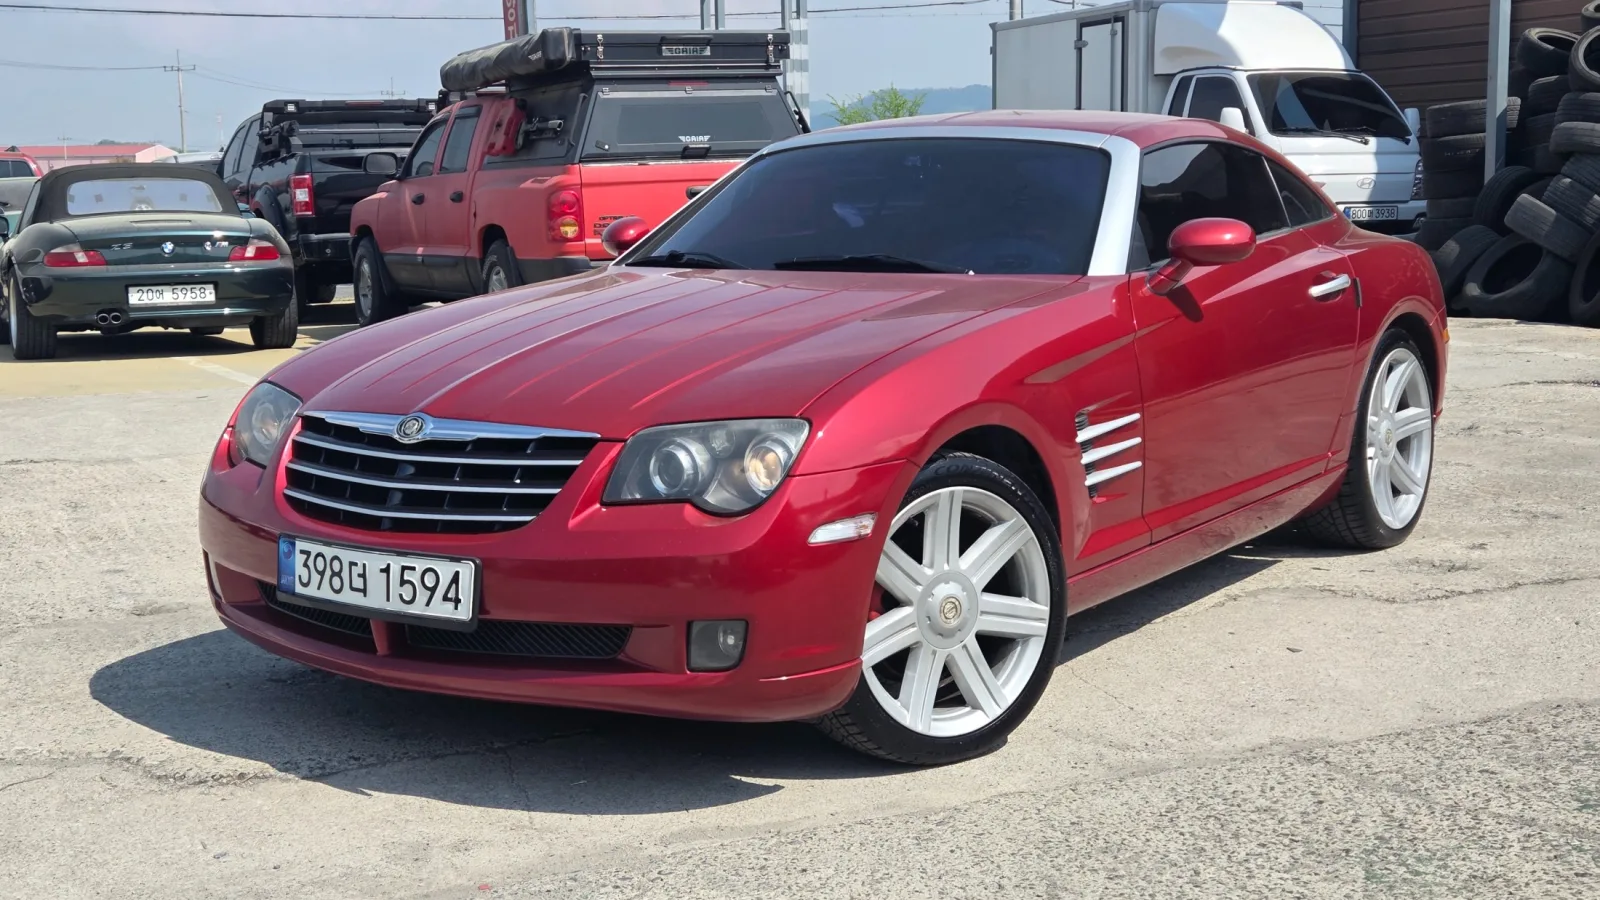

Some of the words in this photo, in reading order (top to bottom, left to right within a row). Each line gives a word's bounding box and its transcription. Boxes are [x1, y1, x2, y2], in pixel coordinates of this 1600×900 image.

[1375, 208, 1396, 219] 3938
[136, 288, 164, 302] 20어
[171, 286, 207, 300] 5958
[298, 549, 367, 598] 398더
[379, 562, 462, 611] 1594
